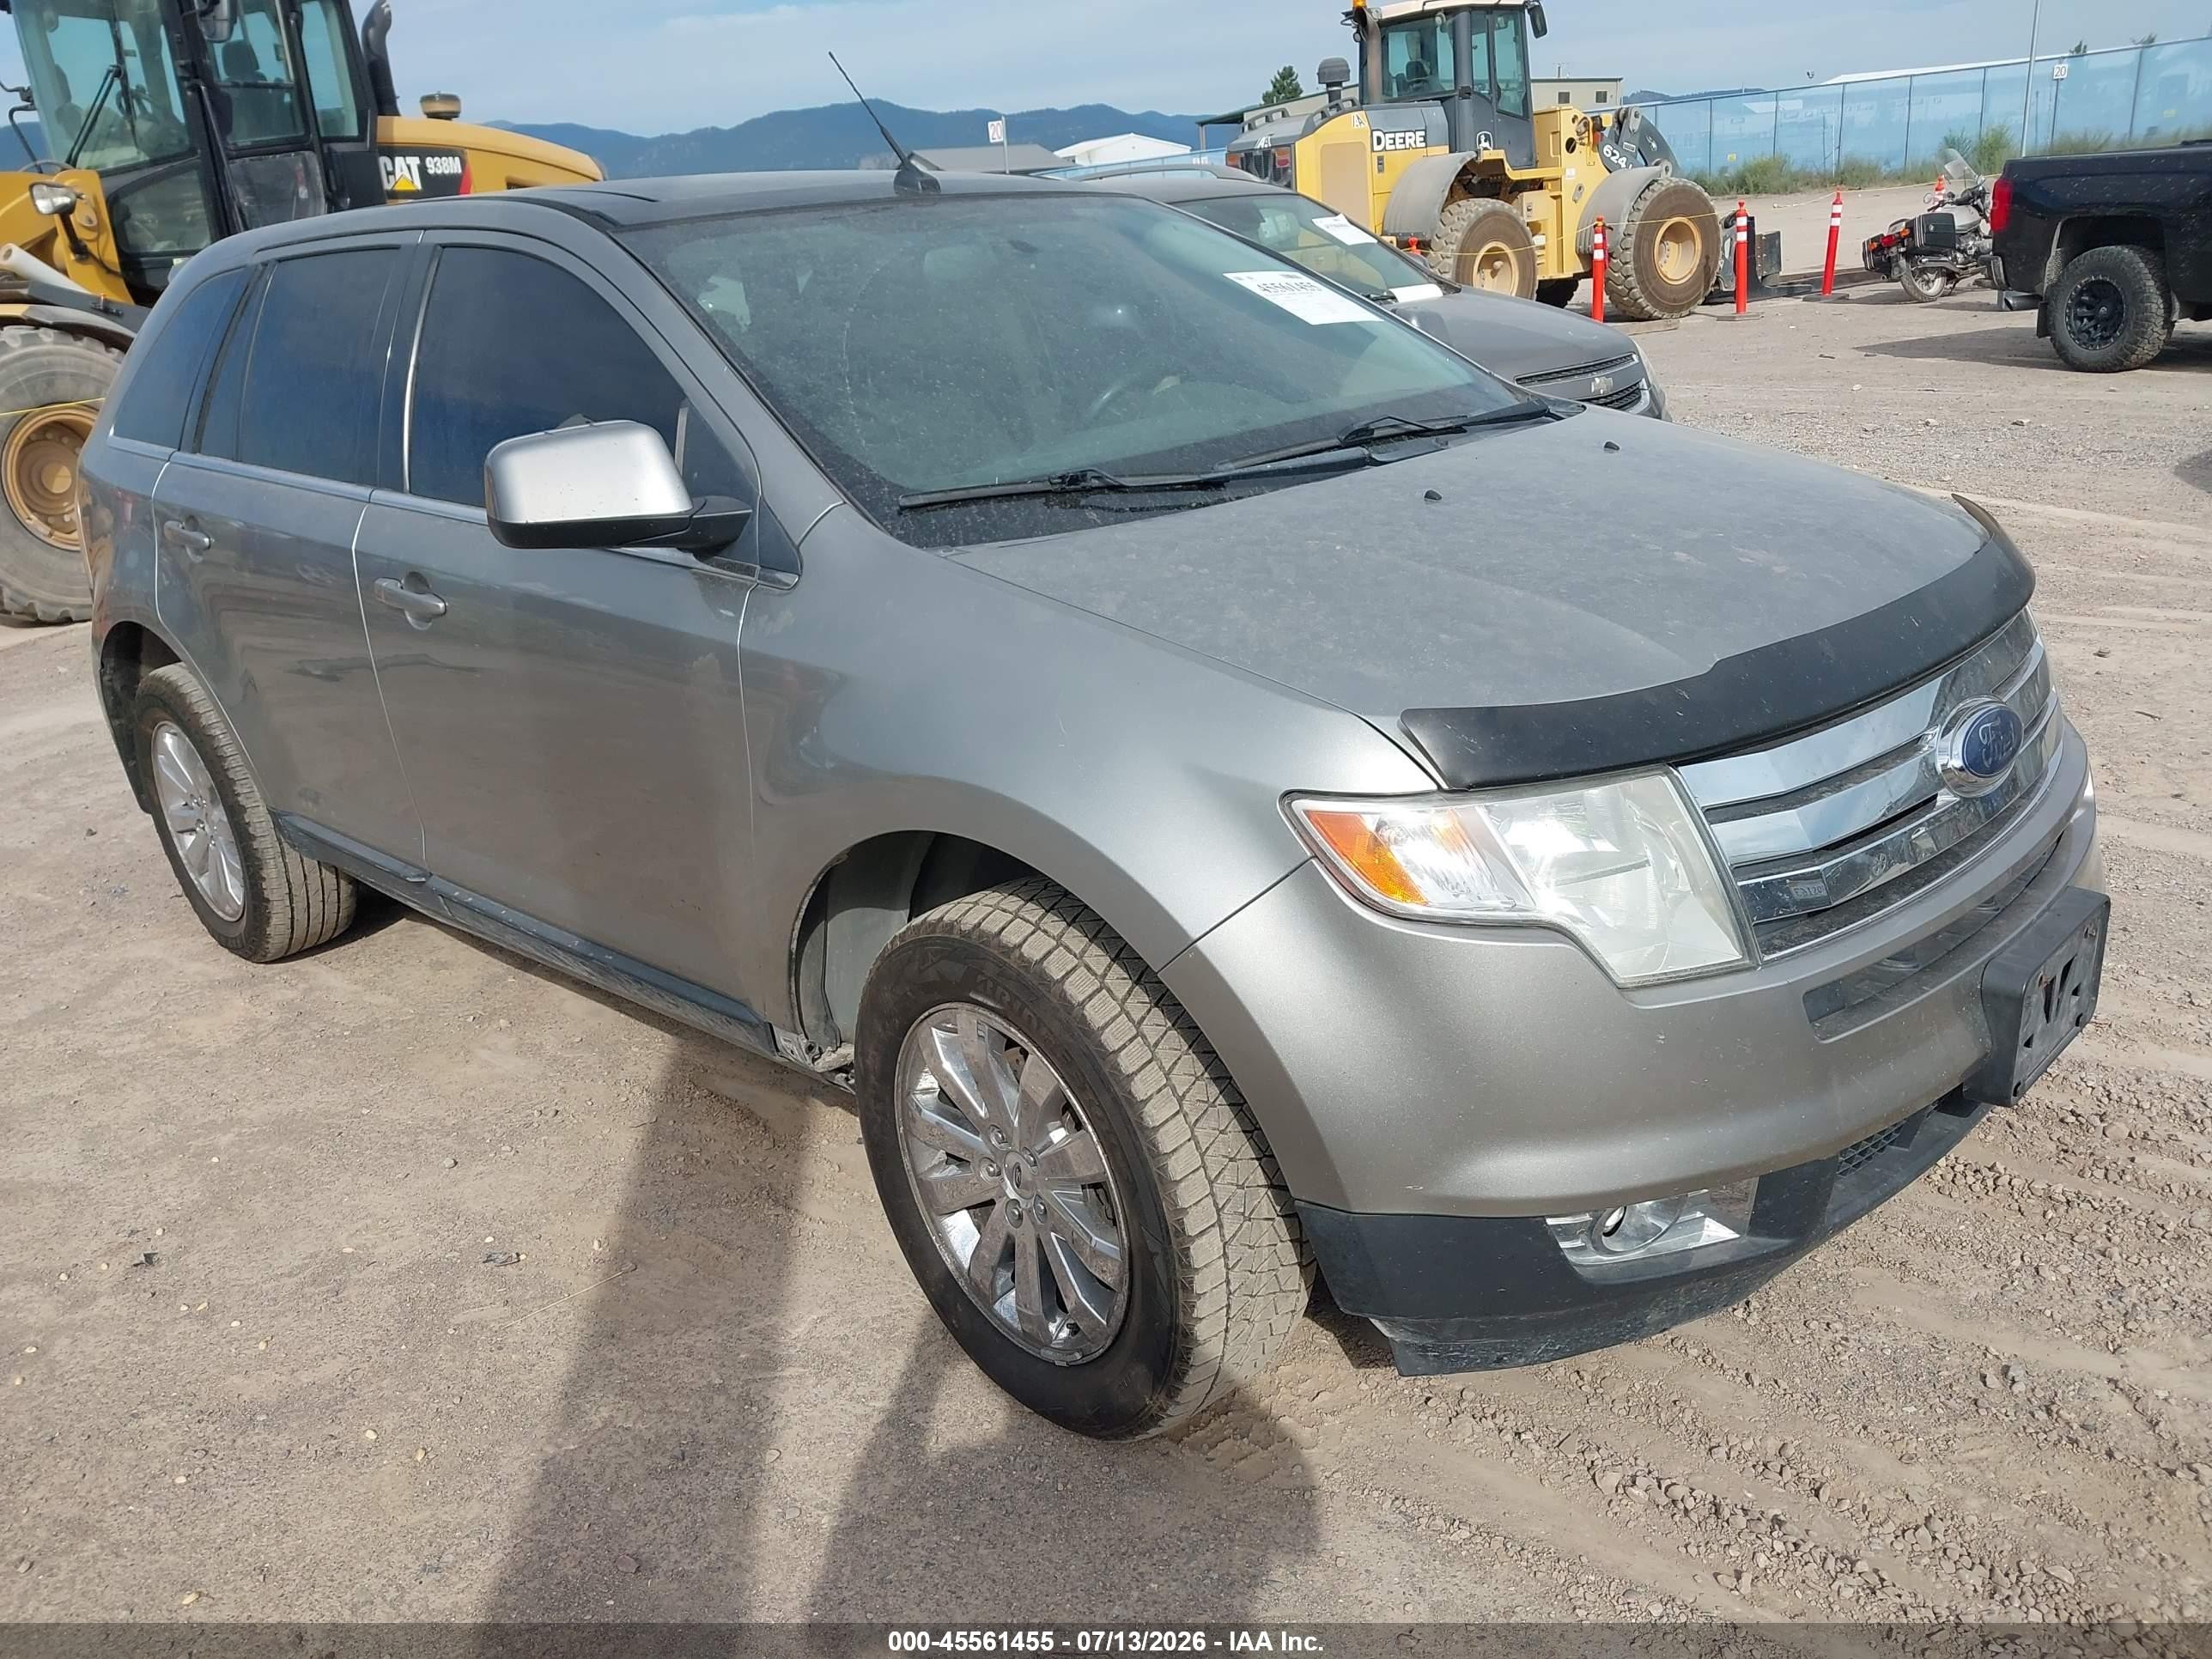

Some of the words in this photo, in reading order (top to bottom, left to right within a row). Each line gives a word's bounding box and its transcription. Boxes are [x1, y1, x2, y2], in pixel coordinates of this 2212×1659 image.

[2055, 66, 2066, 77] 20
[990, 123, 1002, 140] 20
[1372, 130, 1425, 151] DEERE
[1603, 144, 1632, 170] 624
[379, 156, 422, 191] CAT
[425, 156, 462, 174] 938M
[1978, 715, 2014, 769] Ford
